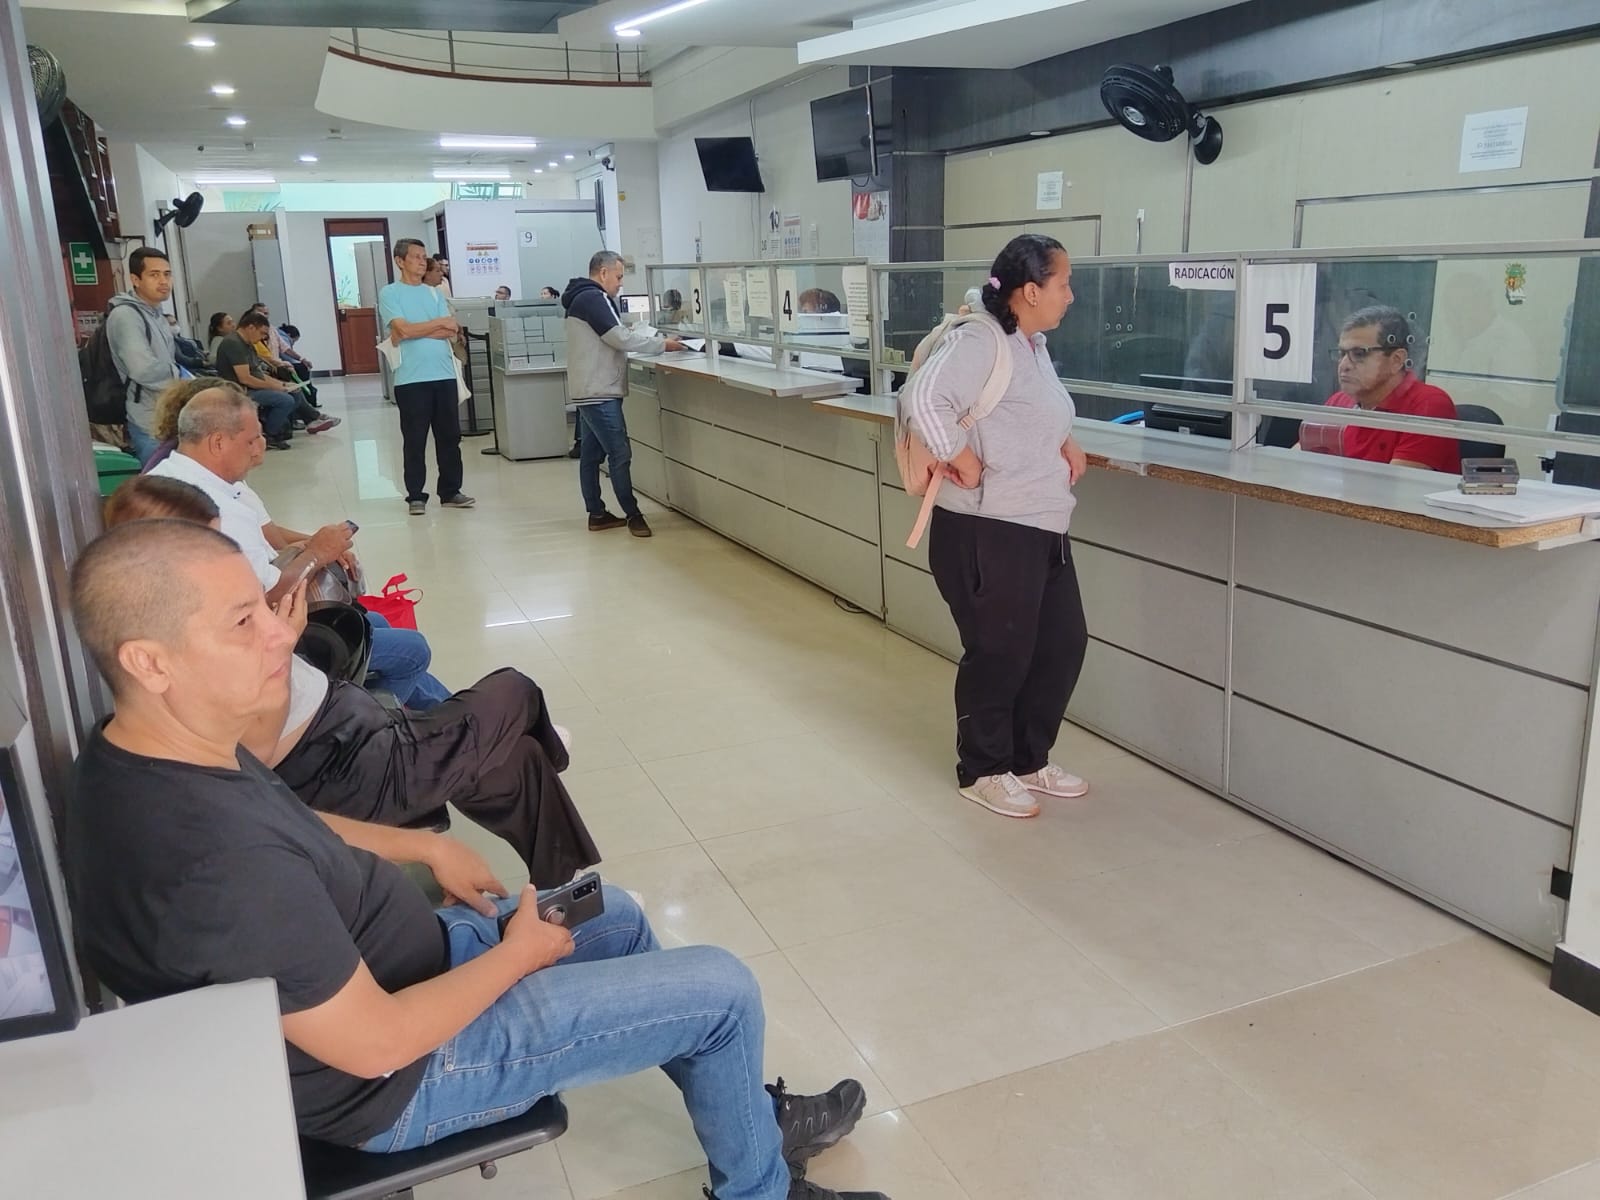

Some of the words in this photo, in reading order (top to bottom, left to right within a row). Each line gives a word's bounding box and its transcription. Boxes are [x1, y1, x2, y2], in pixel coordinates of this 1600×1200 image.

[525, 231, 533, 243] 9
[1174, 265, 1235, 280] RADICACIÓN
[694, 288, 701, 314] 3
[783, 290, 792, 321] 4
[1263, 303, 1291, 359] 5
